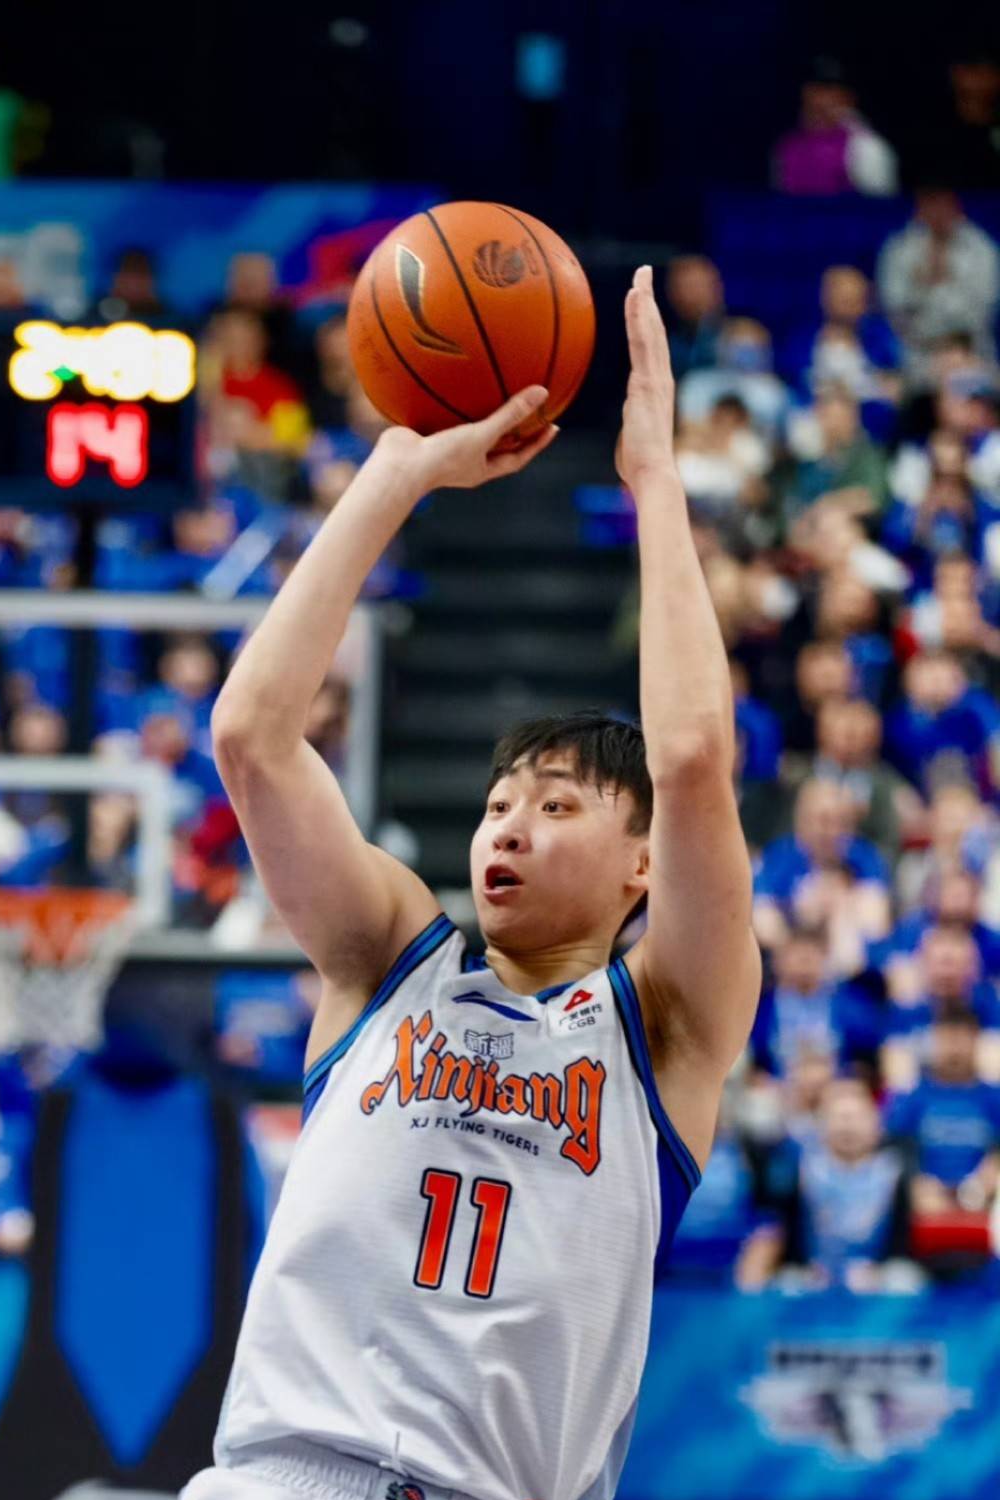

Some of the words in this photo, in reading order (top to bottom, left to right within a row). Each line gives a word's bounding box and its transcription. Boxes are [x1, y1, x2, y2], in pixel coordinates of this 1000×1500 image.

[360, 1010, 606, 1176] Xinjiang
[410, 1117, 429, 1129] XJ
[434, 1117, 485, 1135] FLYING
[492, 1128, 540, 1157] TIGERS
[412, 1167, 513, 1300] 11
